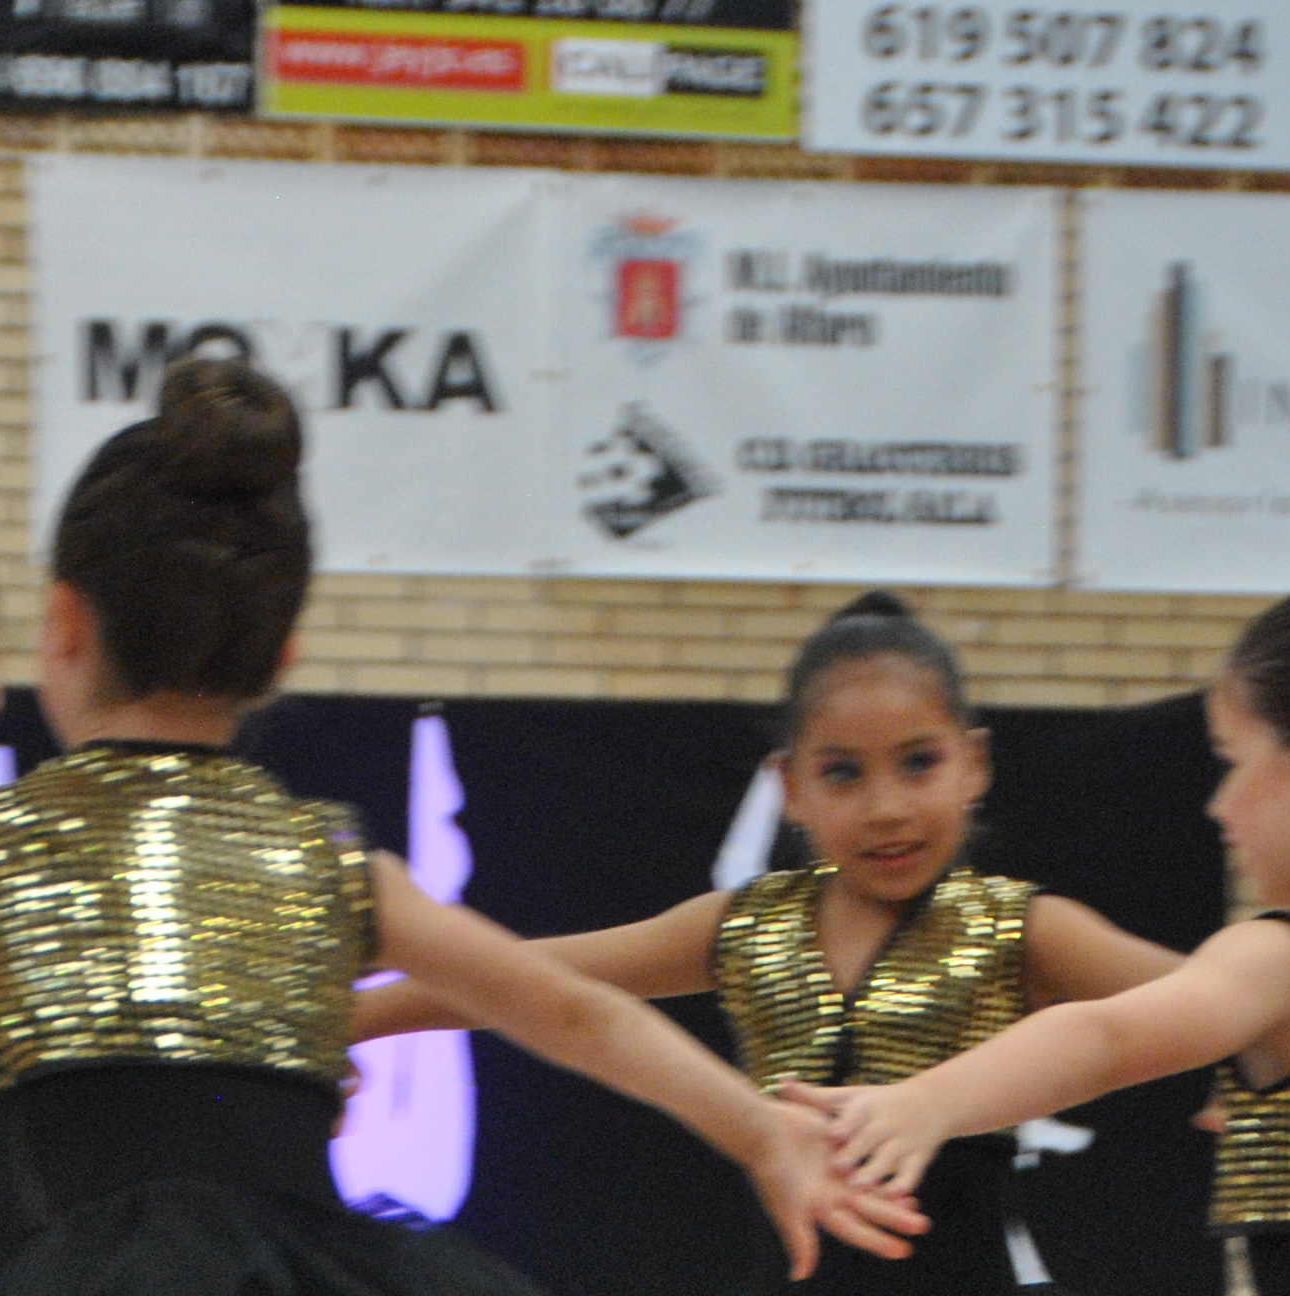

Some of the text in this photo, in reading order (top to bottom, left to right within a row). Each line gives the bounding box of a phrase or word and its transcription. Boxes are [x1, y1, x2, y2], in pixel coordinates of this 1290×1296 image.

[861, 4, 1264, 73] 619 507 824
[860, 81, 1264, 149] 657 315 422
